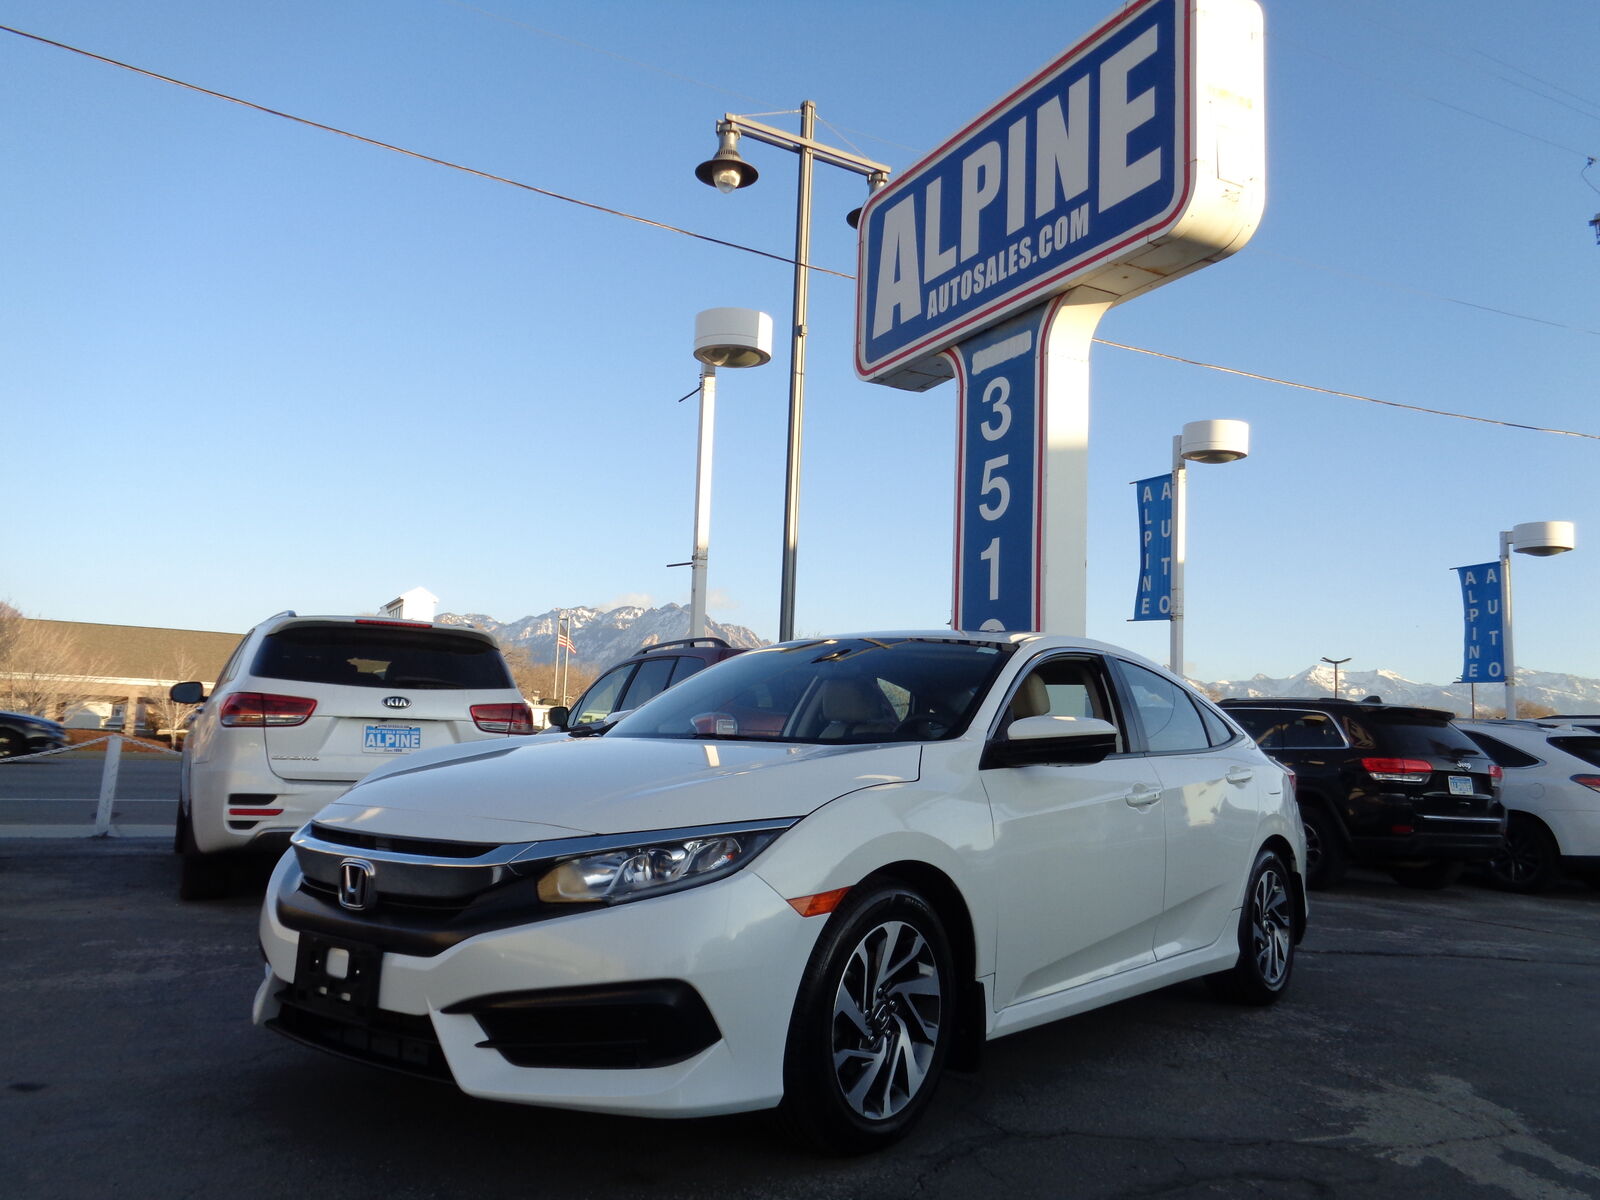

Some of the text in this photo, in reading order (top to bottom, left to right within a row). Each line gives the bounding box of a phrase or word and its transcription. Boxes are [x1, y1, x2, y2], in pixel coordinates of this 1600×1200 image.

[872, 23, 1162, 340] ALPINE
[926, 202, 1089, 320] AUTOSALES.COM
[978, 376, 1012, 632] 351
[1141, 486, 1152, 614] ALPINE
[1159, 482, 1171, 614] AUTO
[1465, 571, 1479, 677] ALPINE
[1486, 569, 1501, 677] AUTO
[366, 733, 420, 748] ALPINE
[386, 698, 407, 706] KIA
